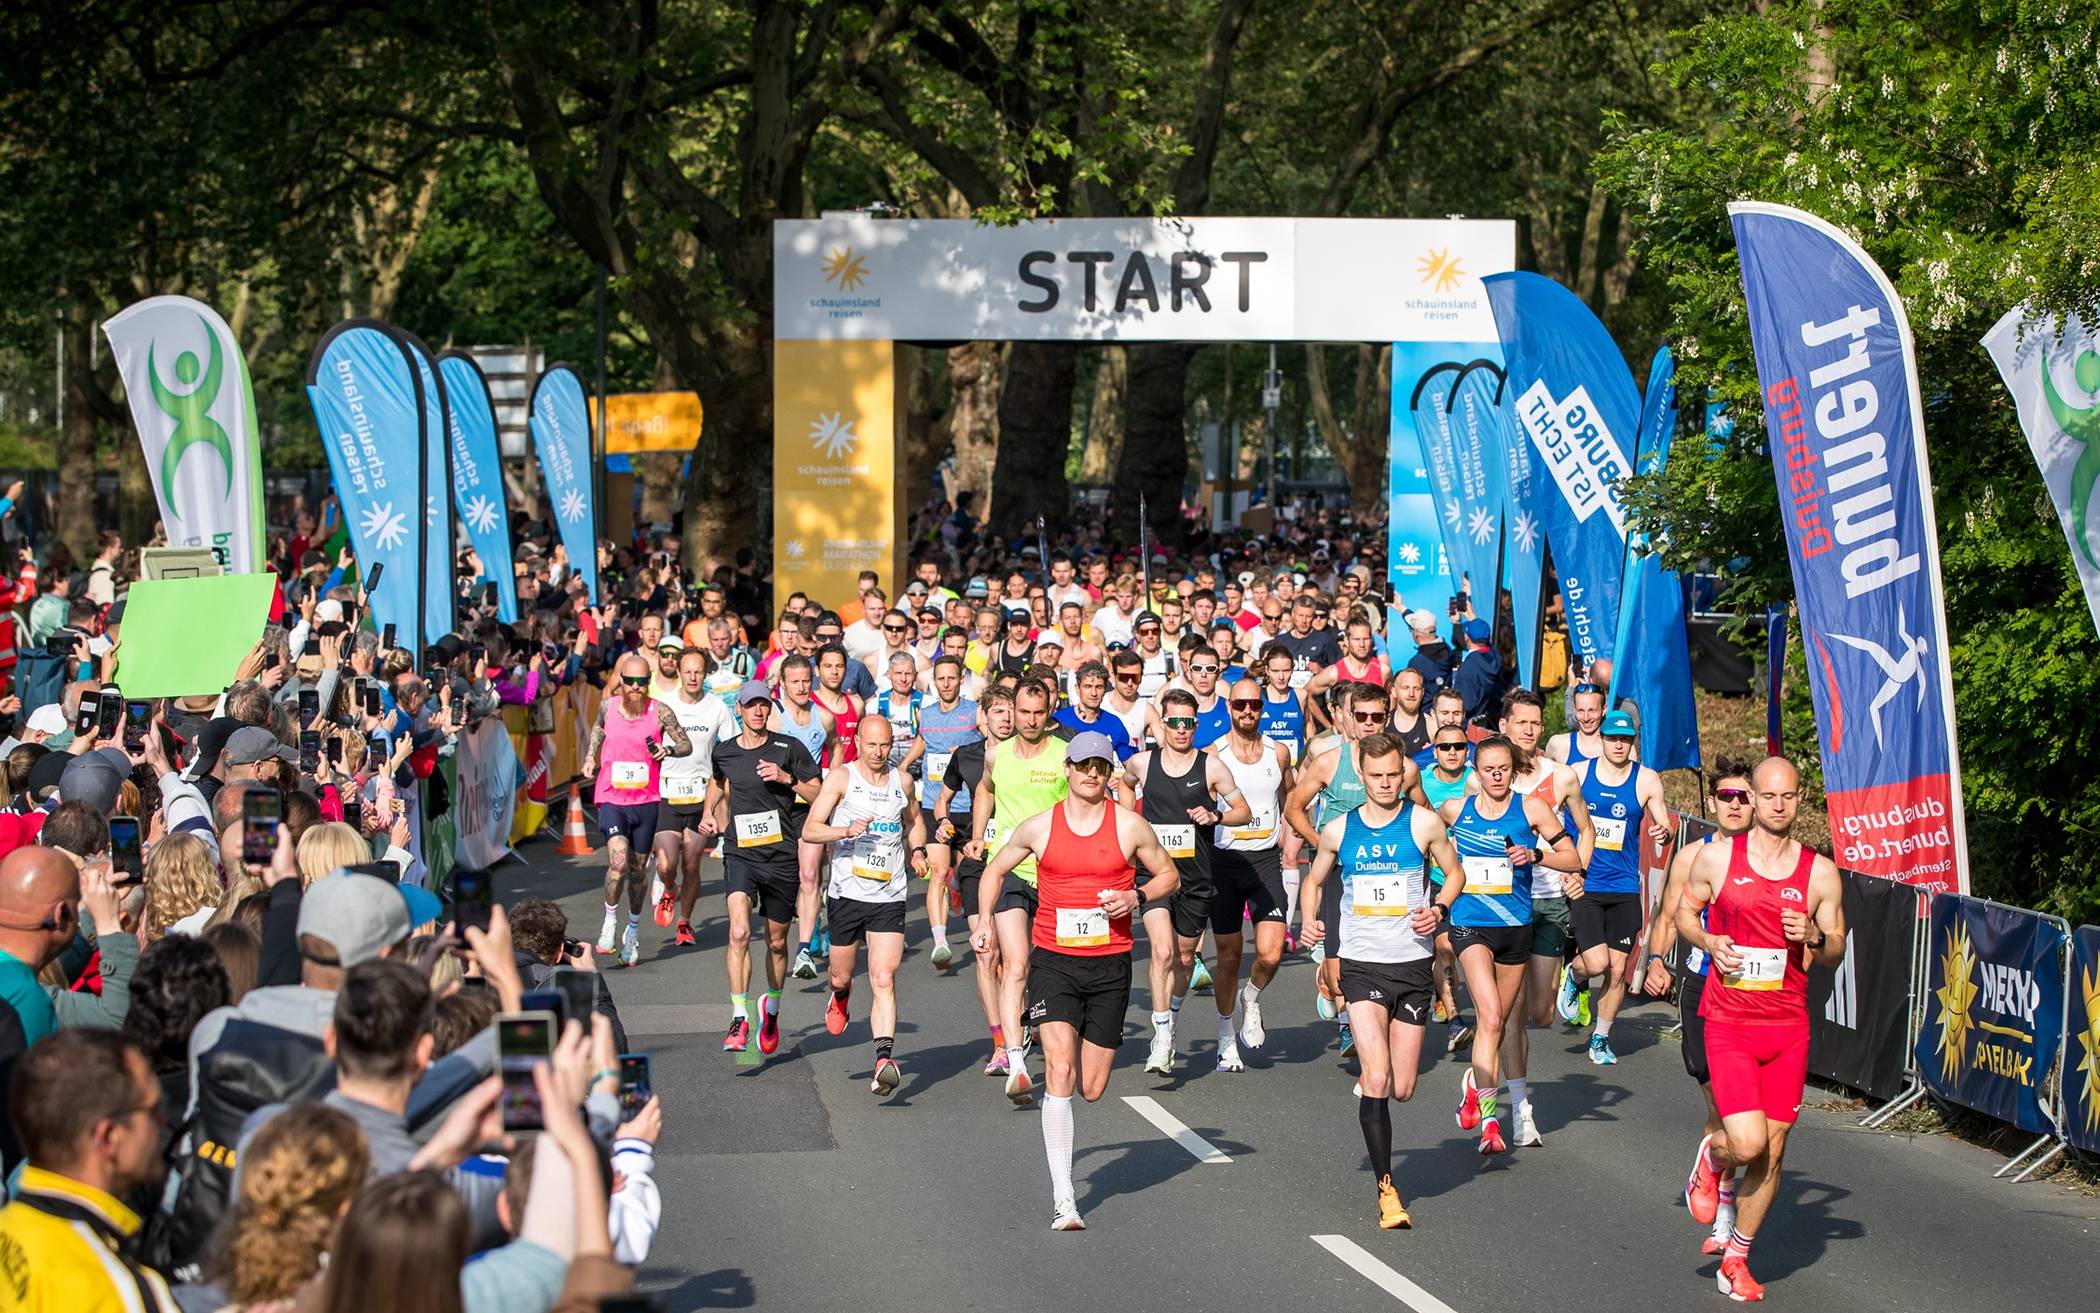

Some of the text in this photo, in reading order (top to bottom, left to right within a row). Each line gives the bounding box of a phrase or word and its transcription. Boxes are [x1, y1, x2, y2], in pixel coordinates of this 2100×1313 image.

[1017, 251, 1268, 313] START
[810, 297, 881, 308] schauinsland
[1405, 299, 1477, 309] schauinsland
[829, 308, 863, 318] reisen
[1424, 311, 1458, 320] reisen
[798, 464, 870, 475] schauinsland
[816, 476, 851, 486] reisen
[1270, 721, 1288, 729] ASV
[625, 771, 635, 780] 39
[678, 786, 693, 795] 1136
[748, 822, 769, 835] 1355
[1162, 835, 1183, 847] 1163
[866, 854, 886, 868] 1328
[1356, 862, 1399, 872] Duisburg
[1485, 869, 1489, 881] 1
[1373, 888, 1385, 902] 15
[1077, 923, 1089, 935] 12
[1749, 961, 1761, 976] 11
